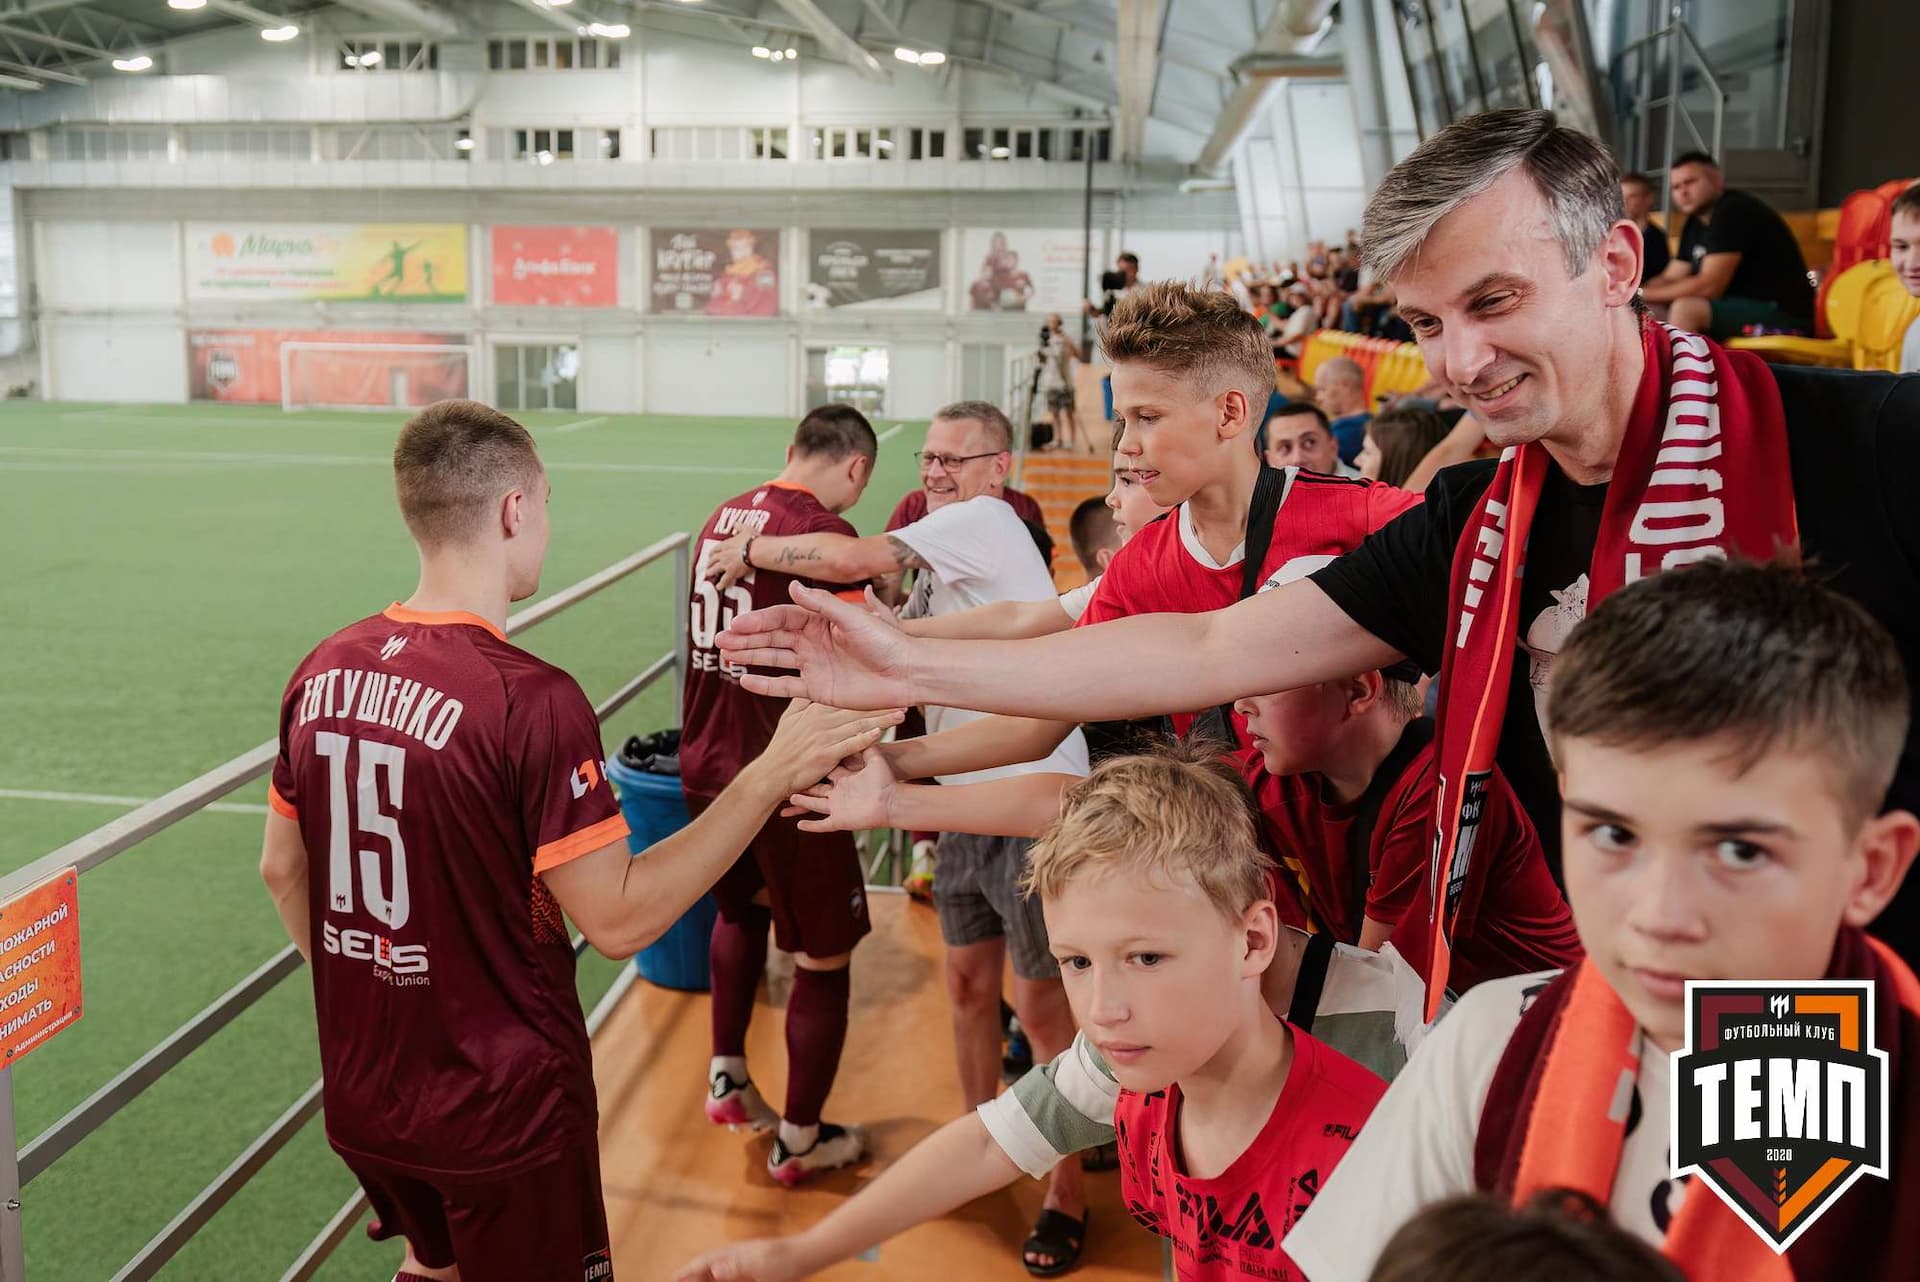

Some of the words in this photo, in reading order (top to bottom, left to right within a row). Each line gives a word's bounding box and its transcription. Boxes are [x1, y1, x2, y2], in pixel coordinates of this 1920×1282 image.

[300, 668, 464, 751] ЕВТУШЕНКО
[315, 731, 411, 931] 15
[395, 974, 431, 987] Union
